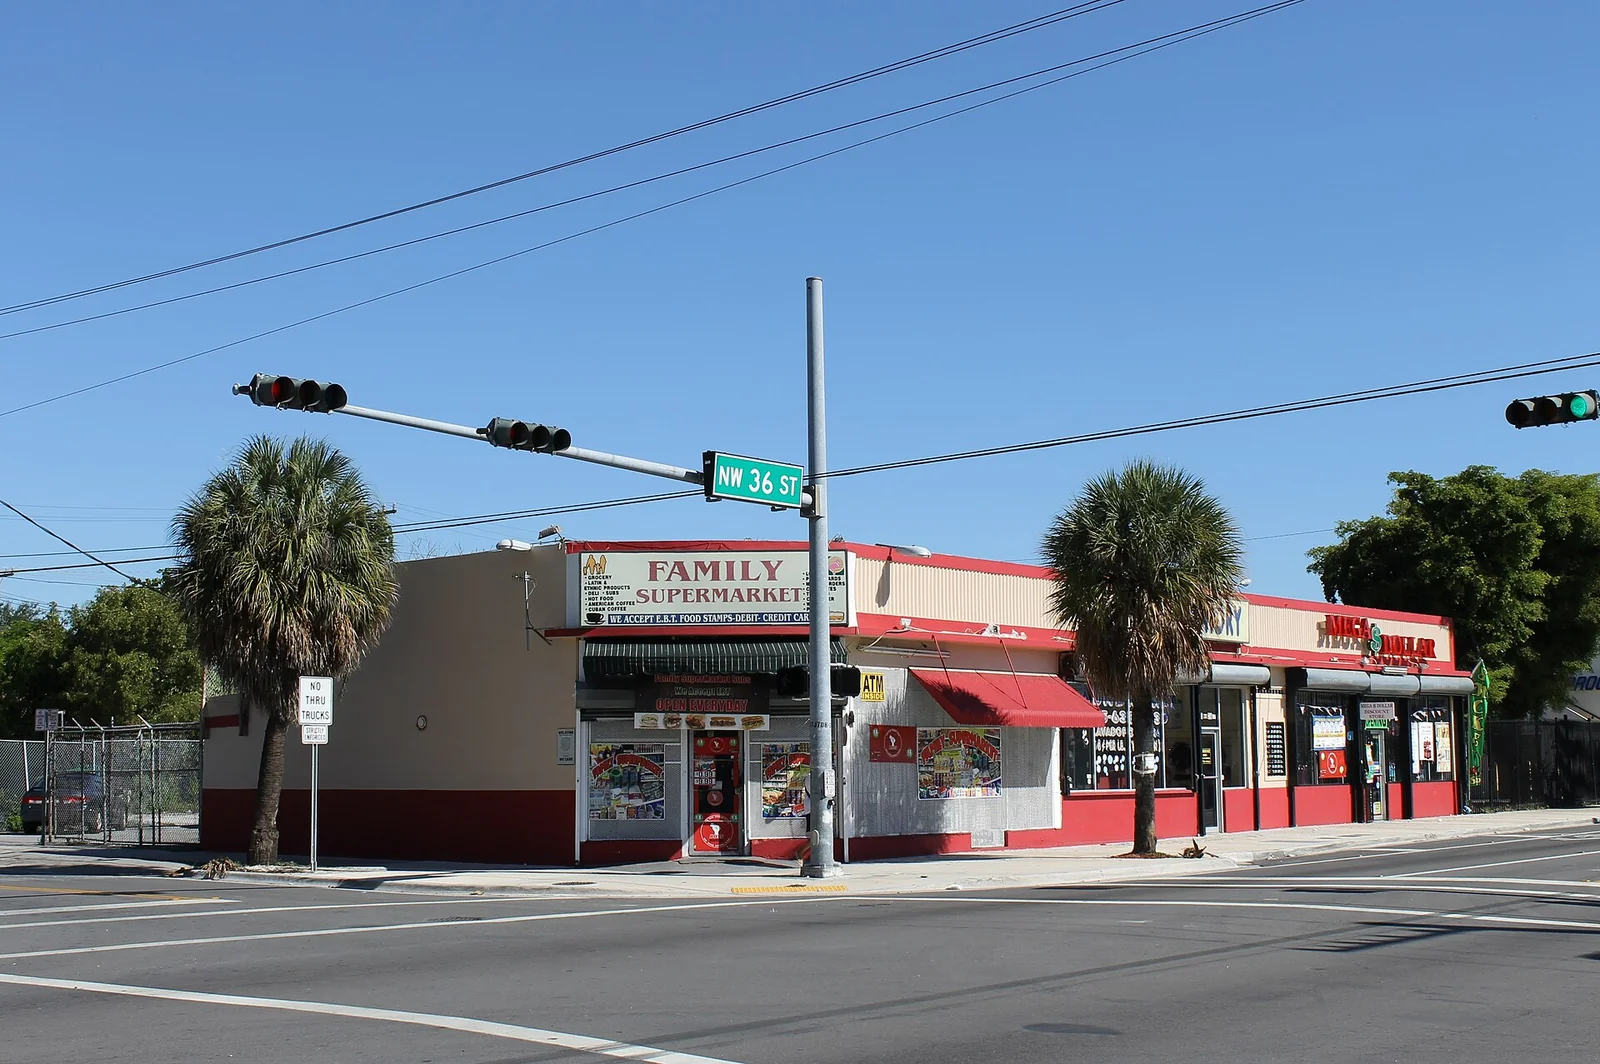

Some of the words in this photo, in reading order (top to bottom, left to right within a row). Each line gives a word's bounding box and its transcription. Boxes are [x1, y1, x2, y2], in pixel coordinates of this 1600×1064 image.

[718, 466, 743, 488] NW
[748, 468, 774, 494] 36
[779, 475, 798, 496] ST
[648, 560, 783, 582] FAMILY
[636, 588, 802, 604] SUPERMARKET
[610, 615, 623, 623] WE
[623, 614, 654, 623] ACCEPT
[656, 614, 678, 622] E.B.T.
[680, 614, 701, 622] FOOD
[762, 613, 792, 622] CREDIT
[794, 613, 810, 621] CAR
[1325, 615, 1371, 639] MEGA
[1380, 634, 1436, 658] DOLLAR
[310, 682, 321, 691] NO
[863, 675, 884, 692] ATM
[306, 696, 326, 705] THRU
[656, 698, 686, 711] OPEN
[690, 699, 748, 712] EVERYDAY
[302, 711, 329, 720] TRUCKS
